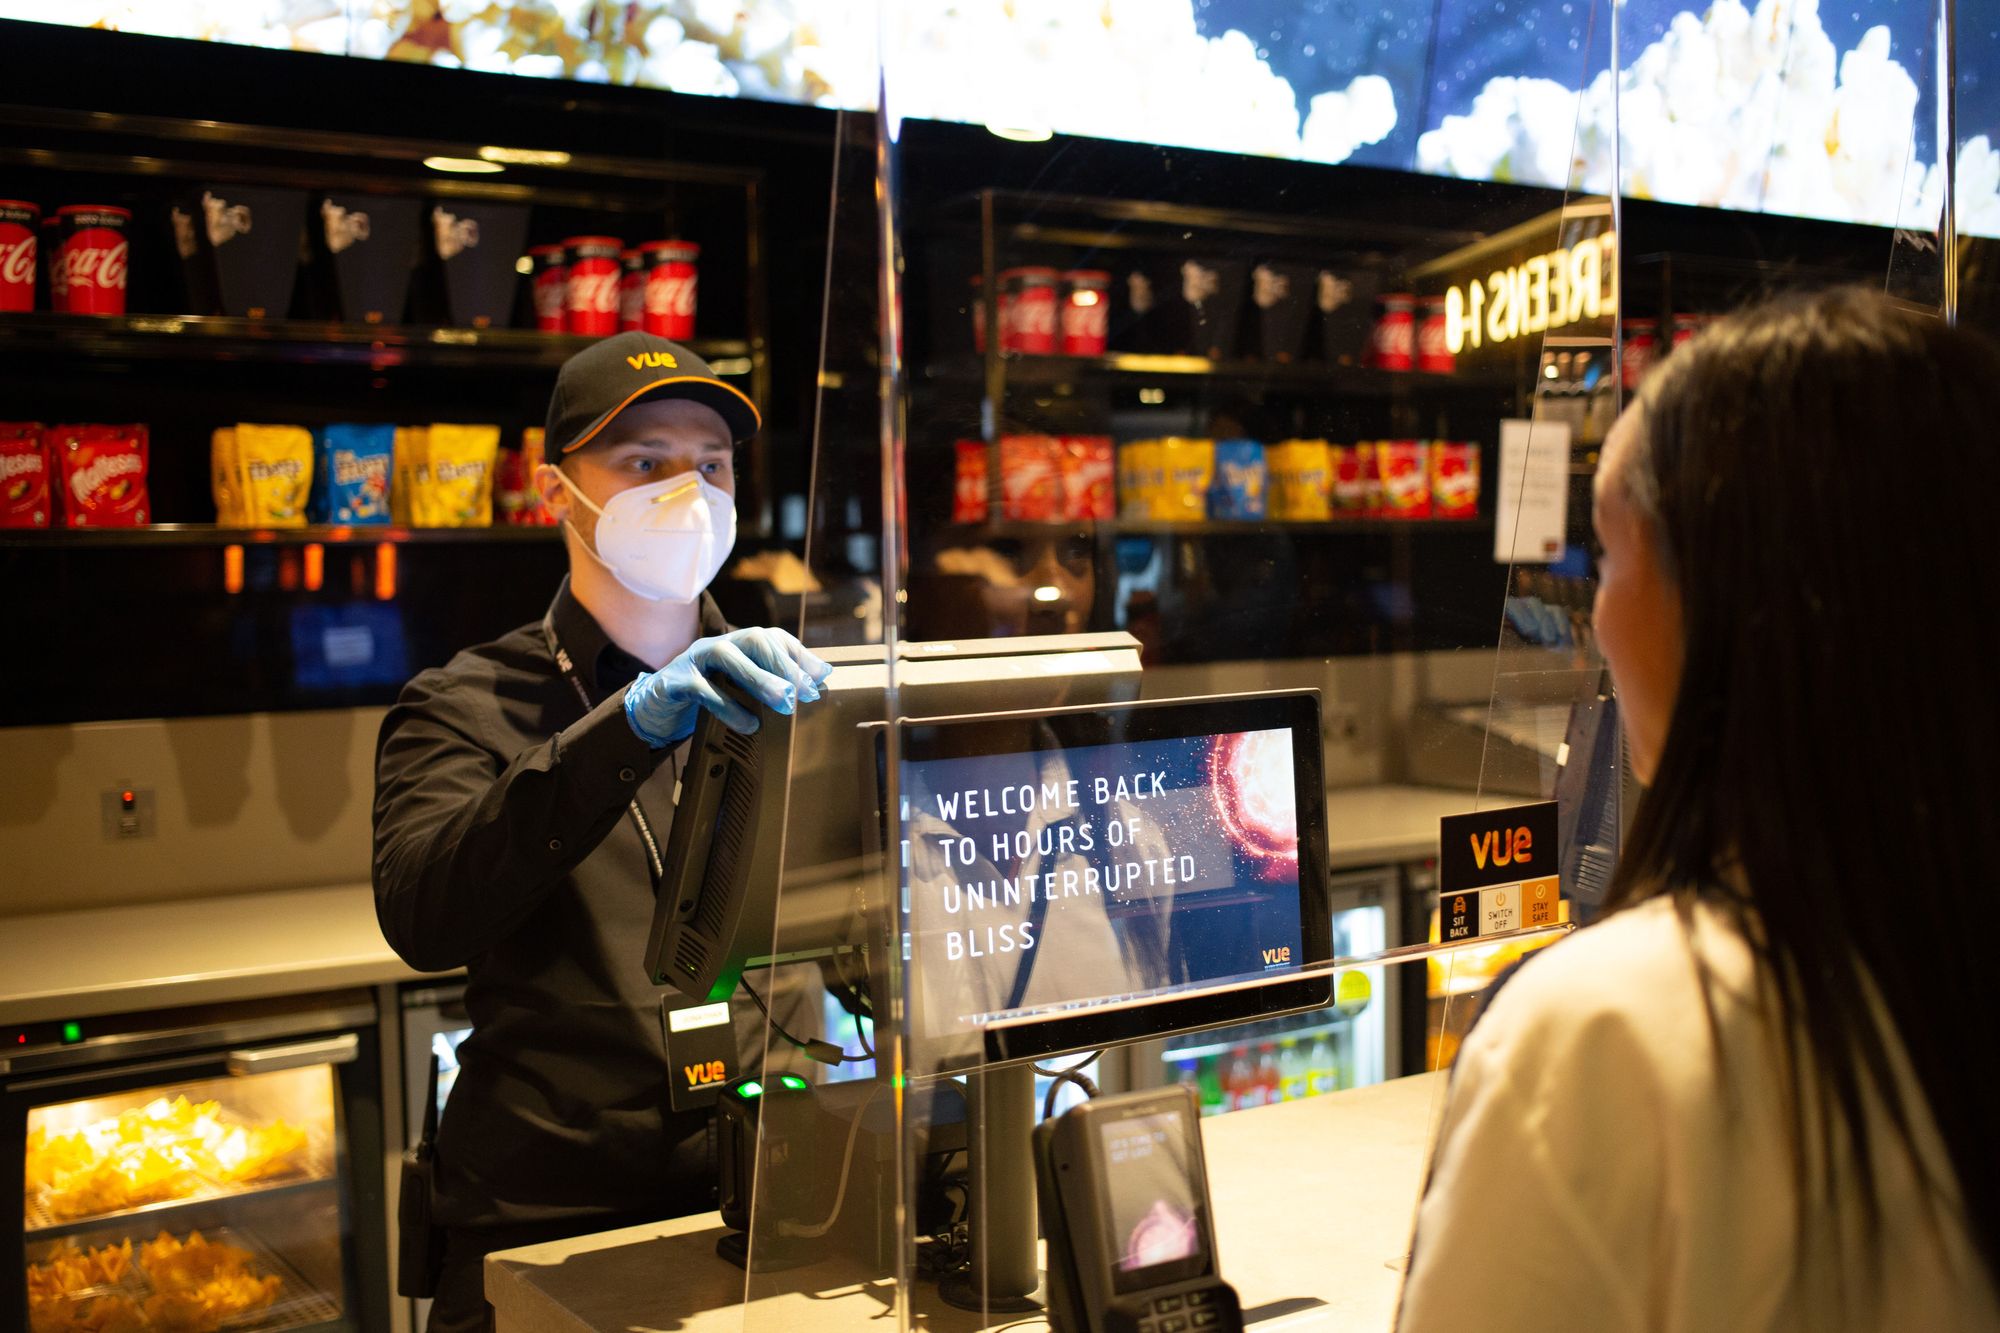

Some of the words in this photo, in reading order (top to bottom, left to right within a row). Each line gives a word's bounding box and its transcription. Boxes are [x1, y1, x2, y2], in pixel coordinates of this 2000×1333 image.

[936, 779, 1081, 822] WELCOME
[1094, 771, 1167, 805] BACK
[939, 836, 976, 868] TO
[992, 823, 1094, 862] HOURS
[1107, 817, 1141, 848] OF
[943, 854, 1196, 914] UNINTERRUPTED
[1532, 901, 1549, 912] STAY
[1488, 908, 1513, 920] SWITCH
[1532, 911, 1549, 922] SAFE
[1453, 916, 1465, 927] SIT
[1494, 920, 1508, 930] OFF
[1449, 926, 1469, 938] BACK
[946, 921, 1035, 961] BLISS
